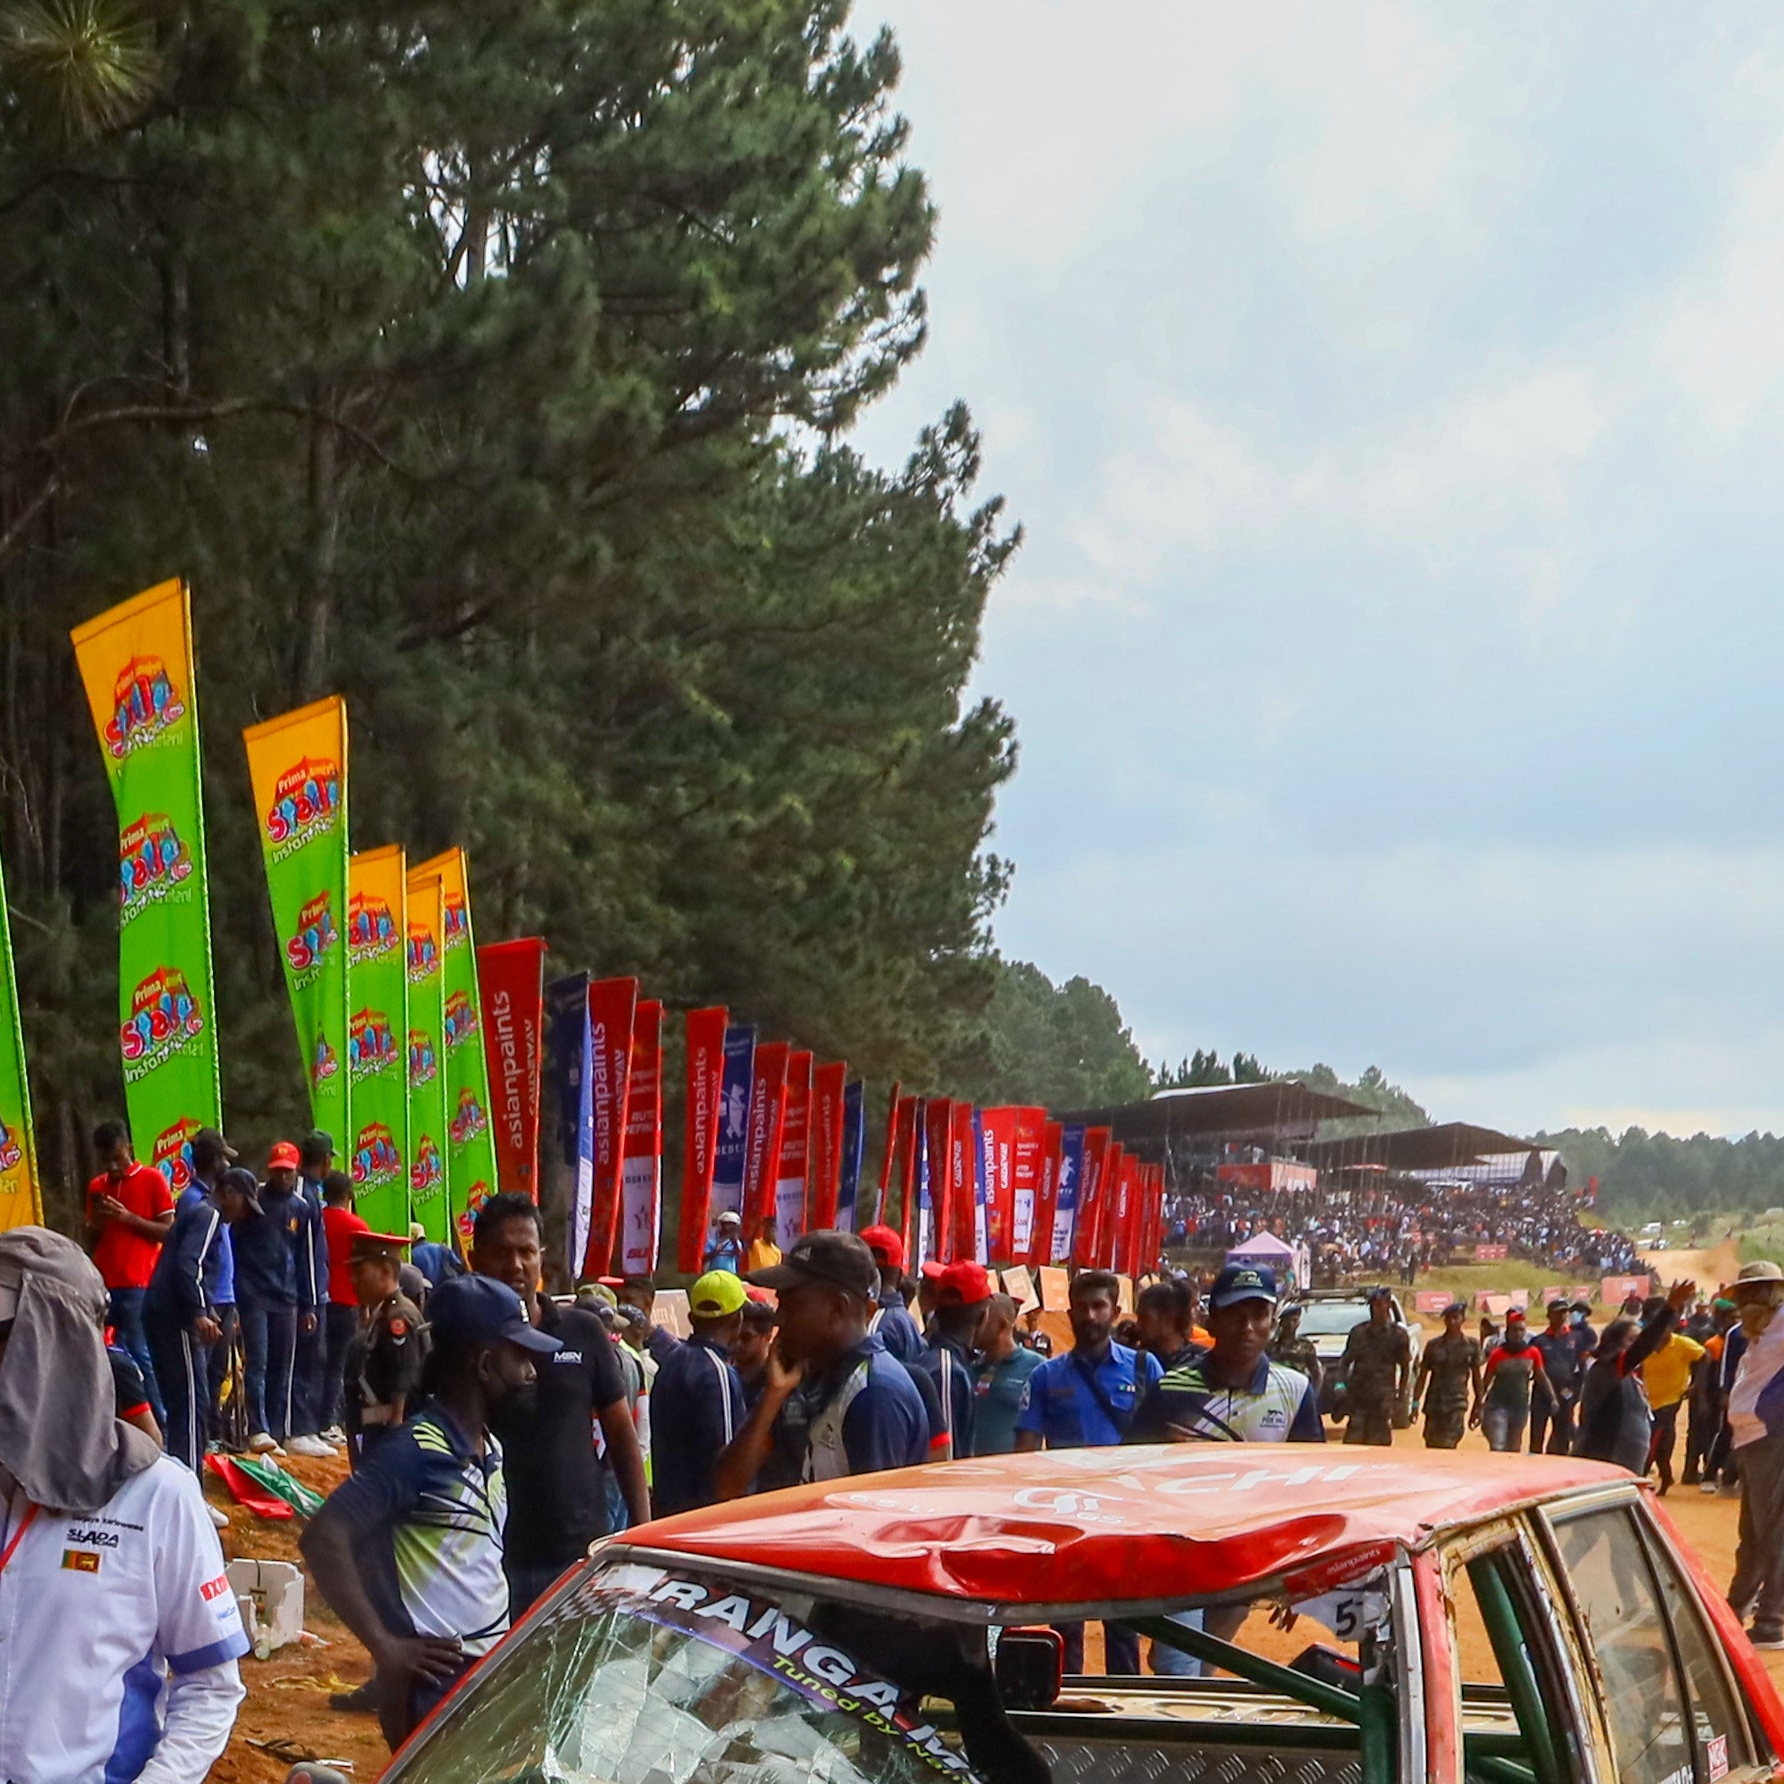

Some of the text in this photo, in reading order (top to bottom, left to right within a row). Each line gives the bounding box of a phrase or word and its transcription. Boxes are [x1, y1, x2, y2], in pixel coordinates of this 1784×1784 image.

[278, 769, 307, 795] Prima
[134, 979, 162, 1006] Prima
[493, 991, 525, 1148] asianpaints
[592, 1022, 613, 1164] asianpaints
[157, 1129, 184, 1154] Prima
[984, 1128, 999, 1204] asianpaints
[1335, 1598, 1357, 1638] 5
[772, 1654, 901, 1737] Tuned by
